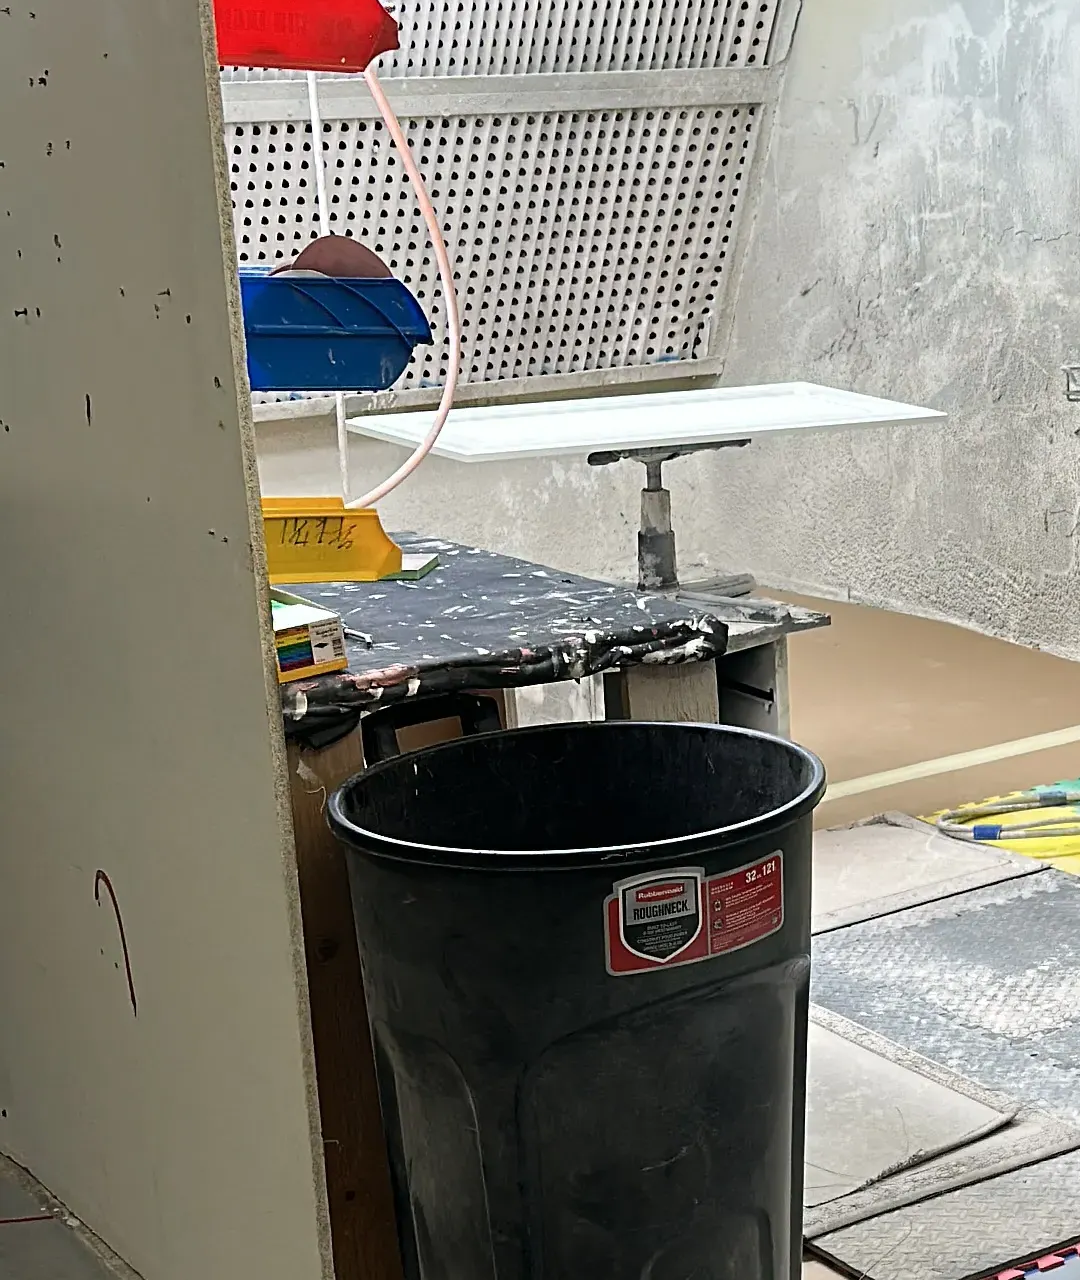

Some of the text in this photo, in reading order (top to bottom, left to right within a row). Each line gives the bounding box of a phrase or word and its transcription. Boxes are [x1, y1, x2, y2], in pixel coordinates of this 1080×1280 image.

[745, 860, 775, 884] 32 121
[638, 886, 683, 899] Rubbermaid
[633, 899, 688, 920] ROUGHNECK
